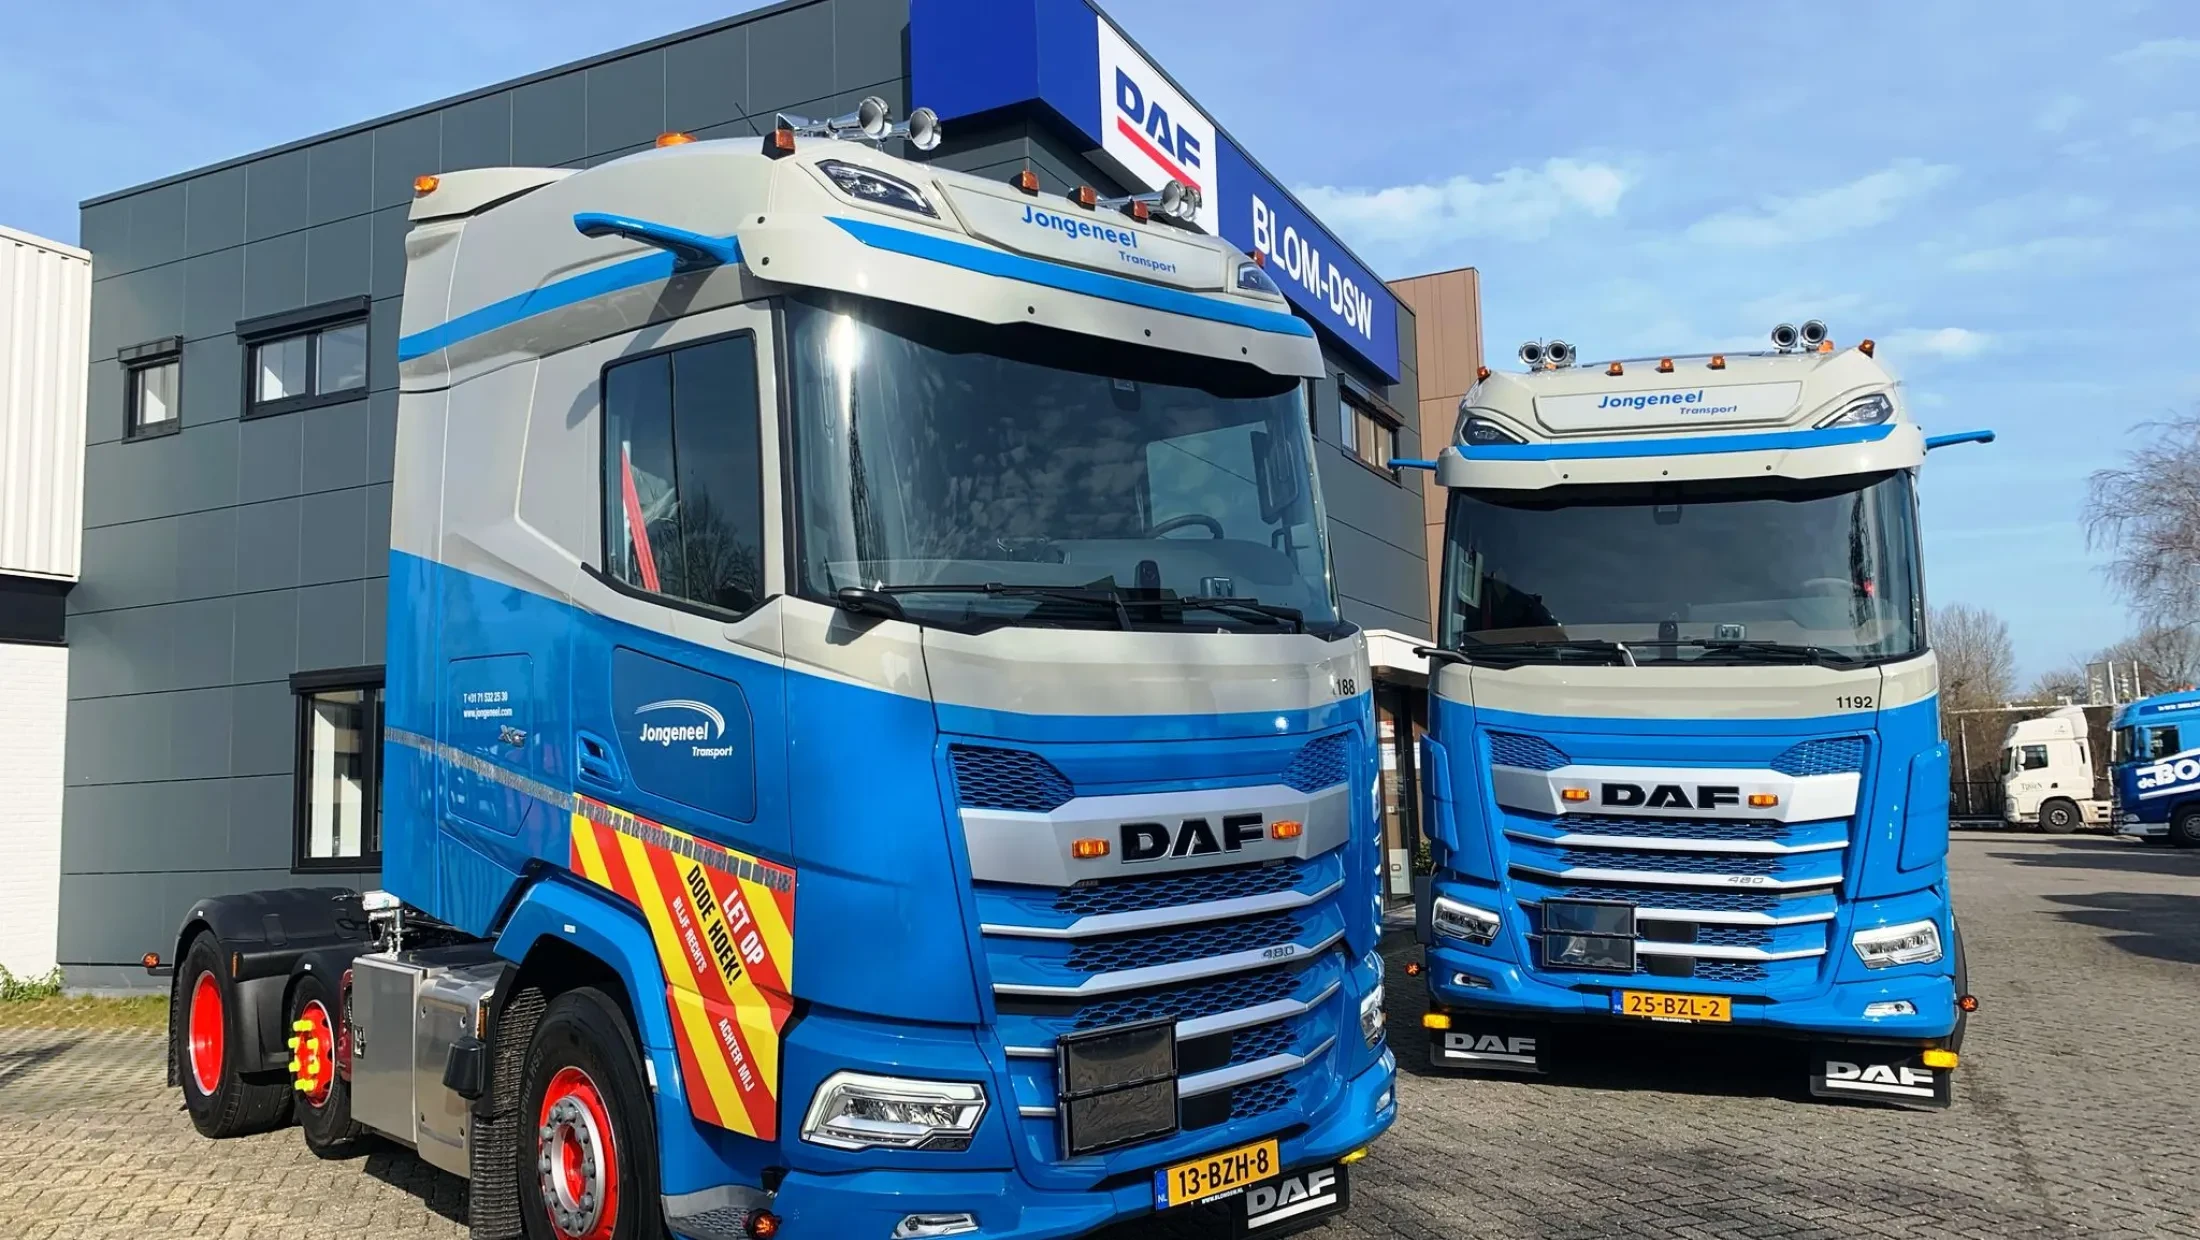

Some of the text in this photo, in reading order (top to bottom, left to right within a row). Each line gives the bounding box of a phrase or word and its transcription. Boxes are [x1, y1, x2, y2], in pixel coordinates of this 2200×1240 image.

[1115, 65, 1200, 170] DAF
[1022, 204, 1138, 248] Jongeneel
[1119, 250, 1176, 274] Transport
[1252, 193, 1373, 341] BLOM-DSW
[1598, 390, 1704, 410] Jongeneel
[1680, 405, 1737, 415] Transport
[1836, 696, 1873, 709] 1192
[640, 721, 709, 747] Jongeneel
[692, 745, 733, 759] Transport
[1601, 782, 1740, 810] DAF
[1120, 812, 1264, 864] DAF
[1728, 876, 1764, 884] 480
[686, 864, 742, 986] DODE HOEK!
[722, 888, 765, 965] LET OP
[684, 927, 708, 974] RECHTS
[1263, 945, 1295, 959] 480
[1631, 995, 1720, 1017] 25-BZL-2
[718, 1017, 755, 1092] ACHTER MIJ
[1445, 1032, 1536, 1053] DAF
[1826, 1060, 1933, 1085] DAF
[1179, 1147, 1269, 1198] 13-BZH-8
[1157, 1194, 1168, 1204] NL
[1246, 1167, 1336, 1216] DAF
